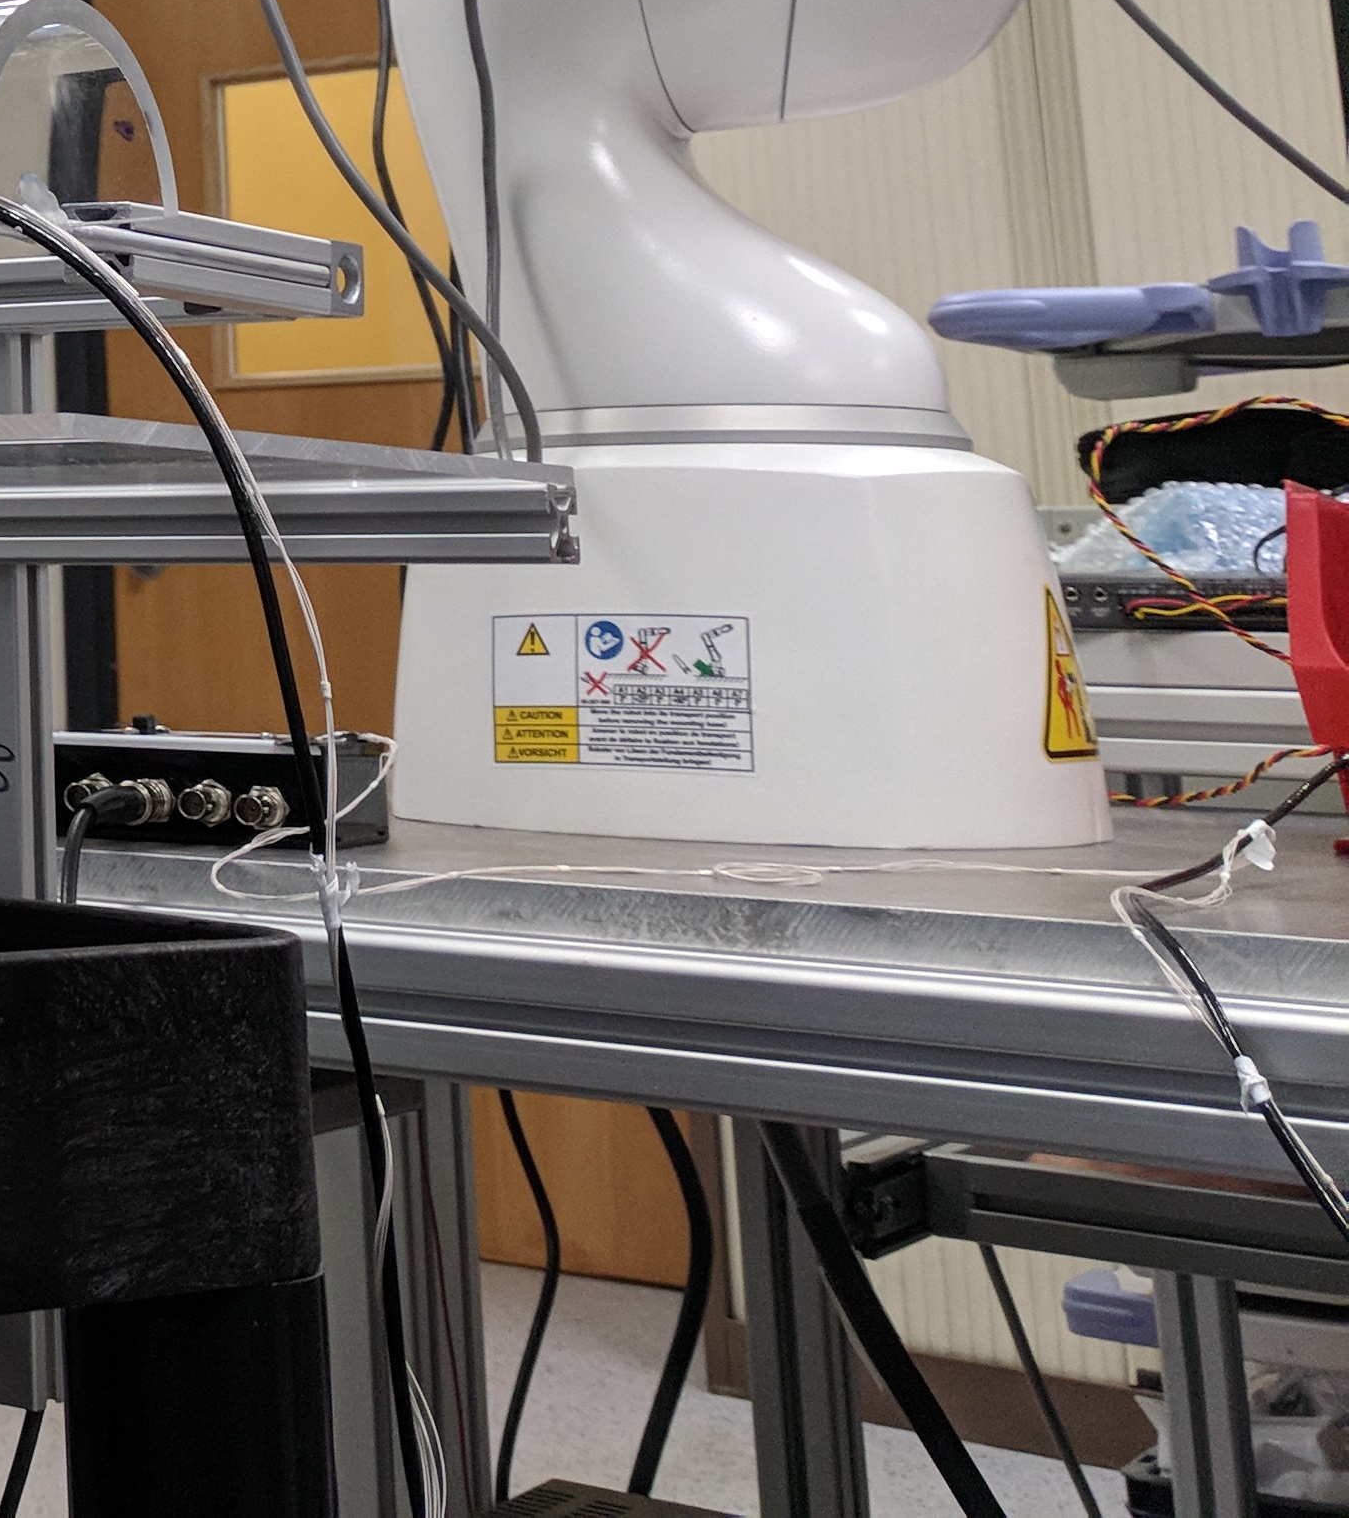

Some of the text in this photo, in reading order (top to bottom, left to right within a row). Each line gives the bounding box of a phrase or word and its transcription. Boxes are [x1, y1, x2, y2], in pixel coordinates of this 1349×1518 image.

[520, 710, 562, 720] CAUTION
[516, 729, 569, 739] ATTENTION
[519, 748, 567, 758] VORSICHT
